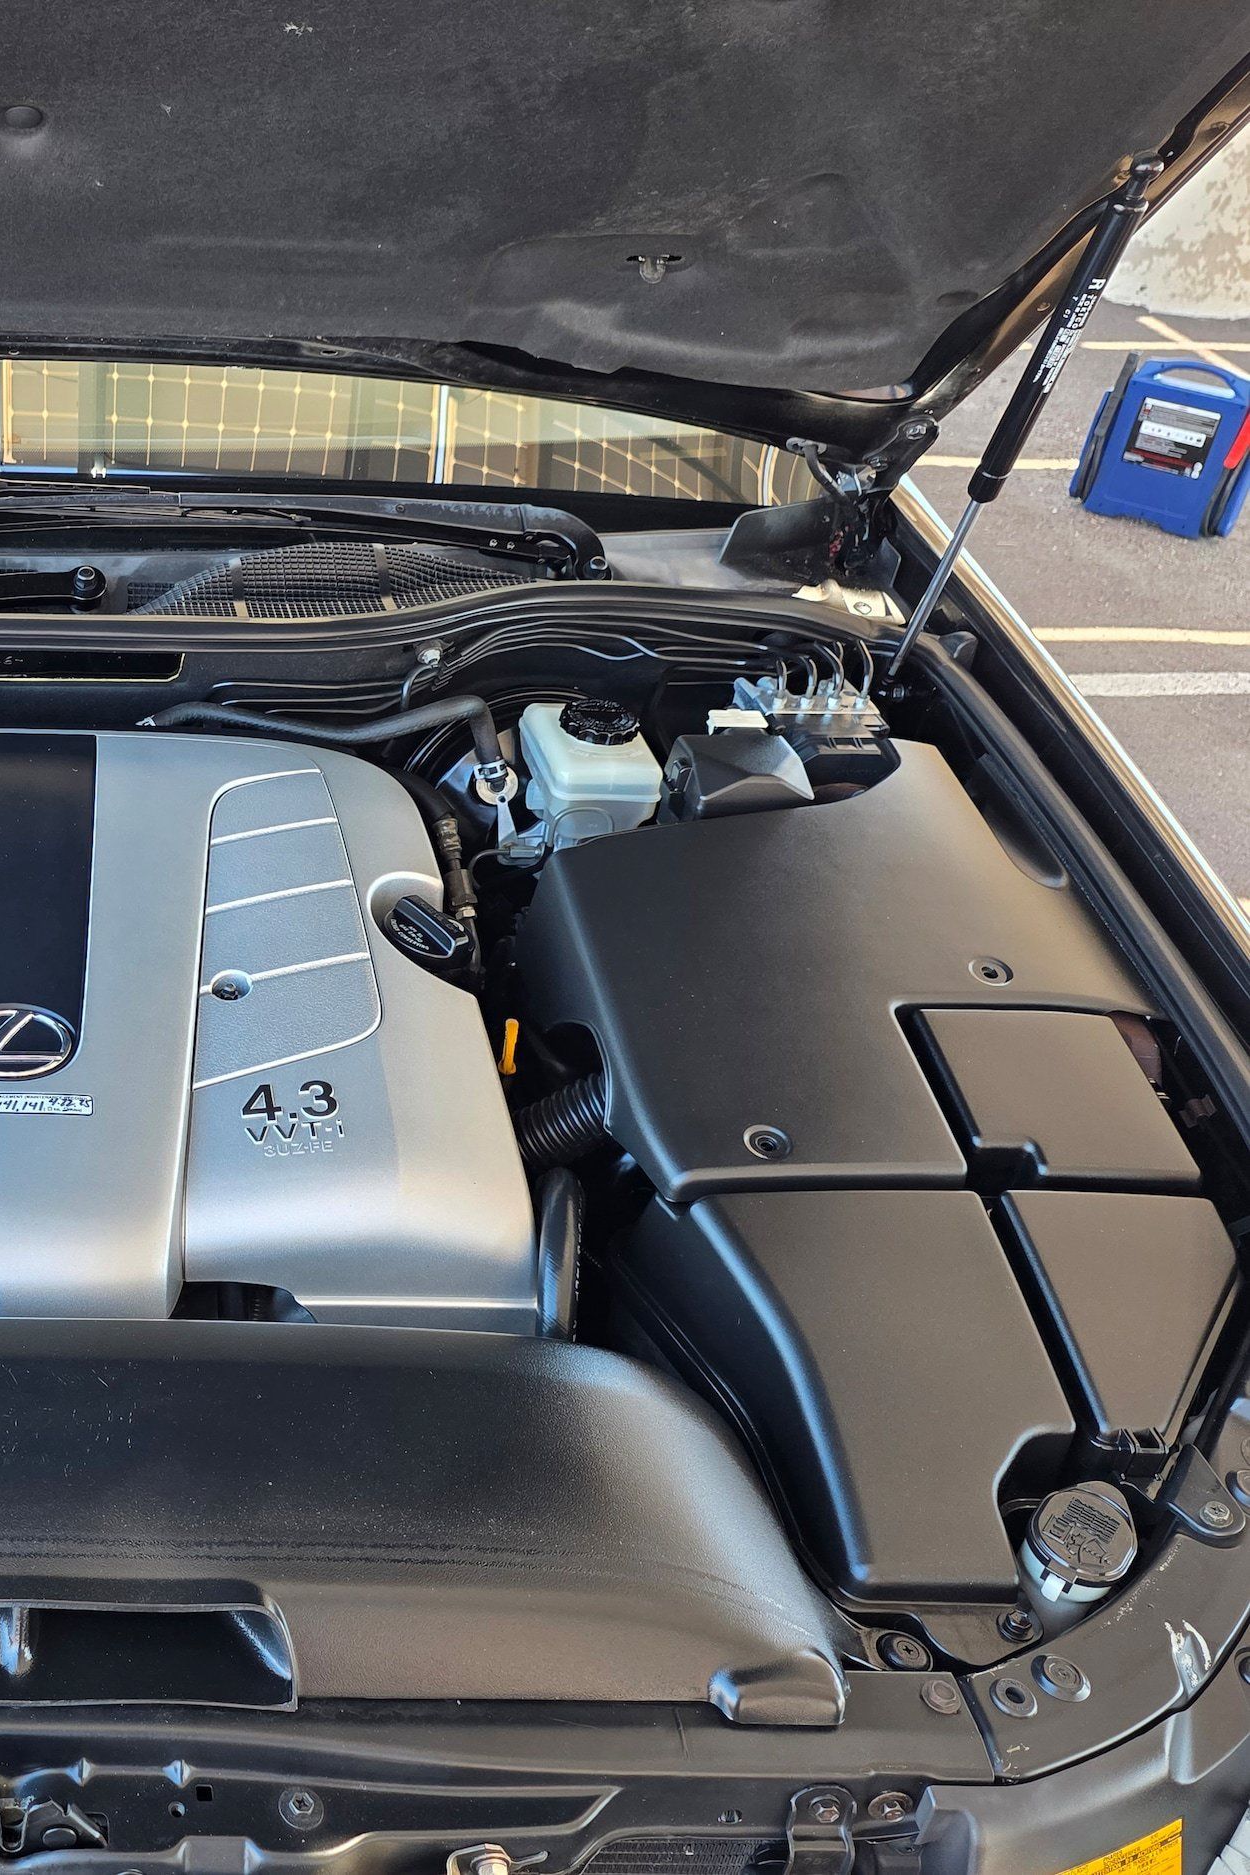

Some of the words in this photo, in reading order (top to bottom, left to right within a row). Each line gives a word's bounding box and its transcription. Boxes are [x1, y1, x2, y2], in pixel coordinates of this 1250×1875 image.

[1088, 279, 1106, 290] R
[1071, 294, 1095, 329] TOKICO
[242, 1080, 339, 1122] 4.3
[245, 1120, 345, 1144] VVT-i
[264, 1141, 333, 1157] 3UZ-FE
